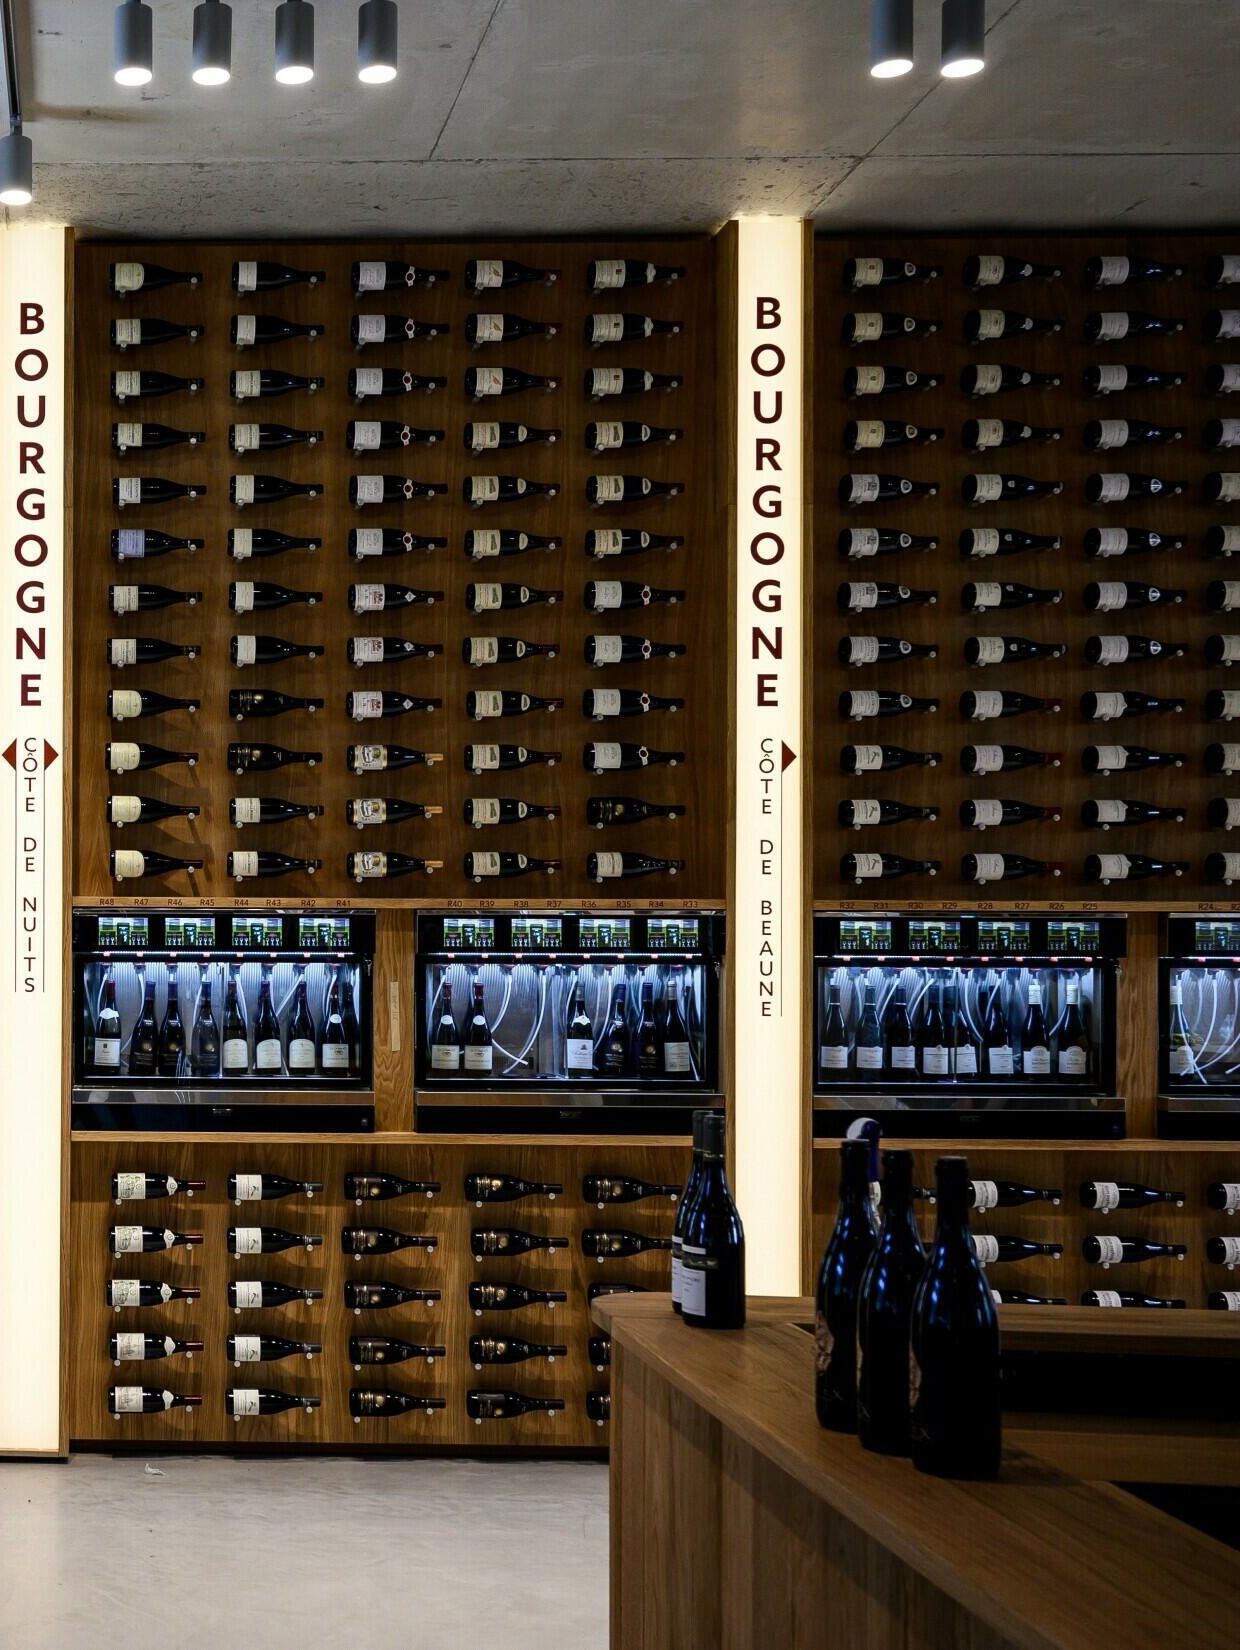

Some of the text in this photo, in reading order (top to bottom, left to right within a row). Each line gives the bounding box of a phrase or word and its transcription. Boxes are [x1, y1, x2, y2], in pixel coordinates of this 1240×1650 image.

[14, 302, 49, 707] BOURGOGNE
[750, 296, 786, 707] BOURGOGNE
[22, 737, 38, 993] CÔTE DE NUITS
[99, 898, 351, 907] R48 R47 R46 R45 R44 R43 R42 R41
[447, 900, 698, 909] R40 R39 R38 R37 R36 R35 R34 R33
[758, 737, 775, 1017] CÔTE DE BEAUNE
